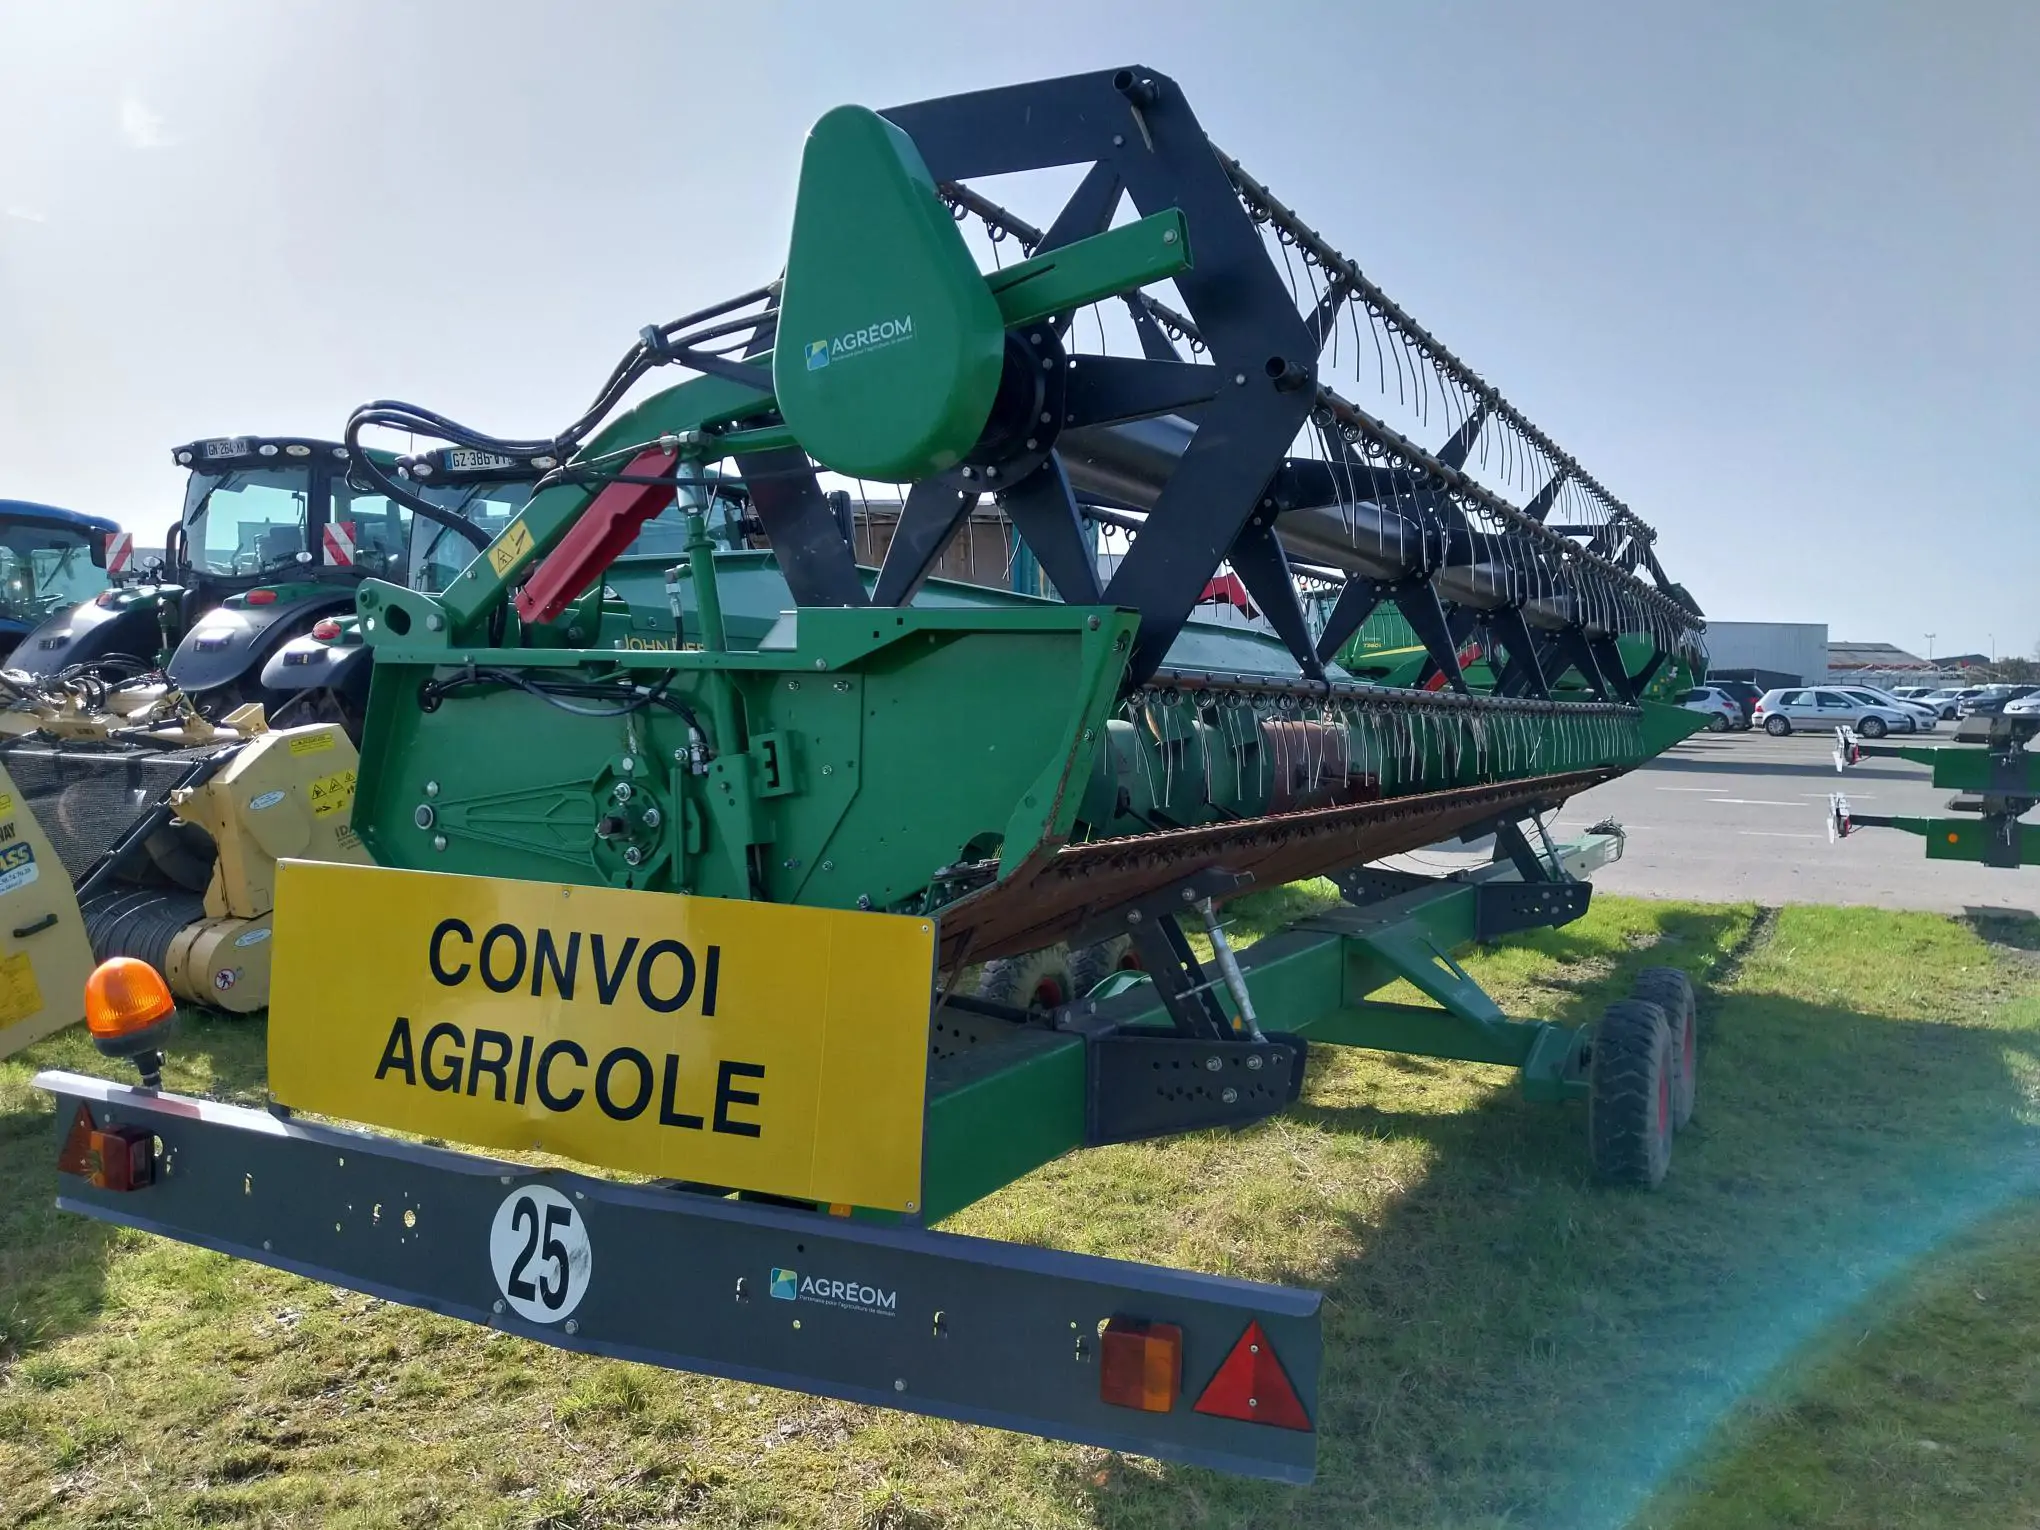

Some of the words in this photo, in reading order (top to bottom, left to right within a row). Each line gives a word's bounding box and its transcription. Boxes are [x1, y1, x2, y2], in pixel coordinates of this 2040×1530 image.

[832, 314, 912, 355] AGRÉOM
[624, 633, 669, 651] JOHN
[672, 637, 705, 651] DEE
[429, 918, 721, 1017] CONVOI
[374, 1017, 766, 1138] AGRICOLE
[508, 1196, 572, 1310] 25
[800, 1276, 896, 1309] AGRÉOM
